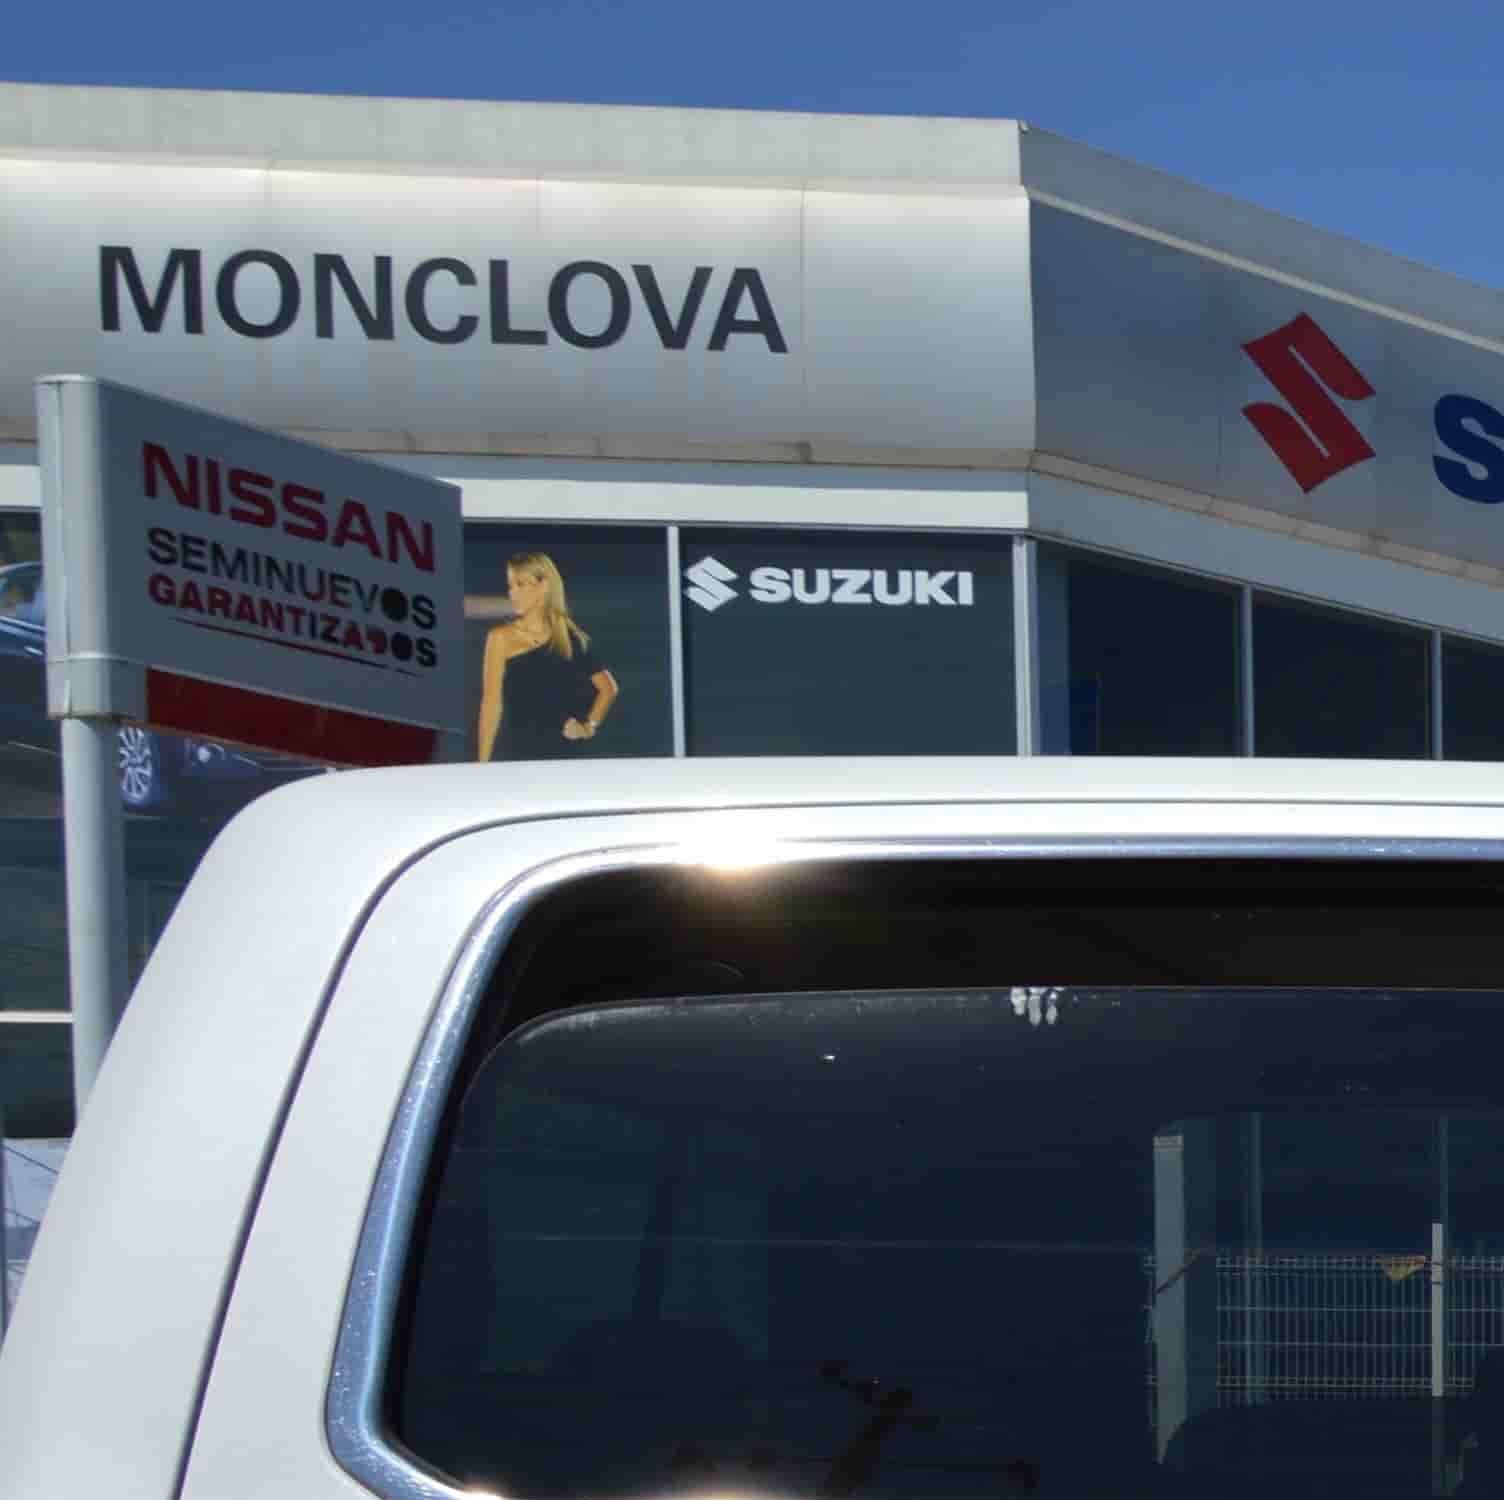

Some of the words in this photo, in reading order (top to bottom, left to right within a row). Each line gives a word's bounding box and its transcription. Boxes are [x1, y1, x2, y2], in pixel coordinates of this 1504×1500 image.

[98, 244, 789, 353] MONCLOVA
[143, 441, 436, 573] NISSAN
[147, 528, 437, 630] SEMINUEVOS
[148, 575, 438, 668] GARANTIZADOS
[750, 566, 974, 605] SUZUKI
